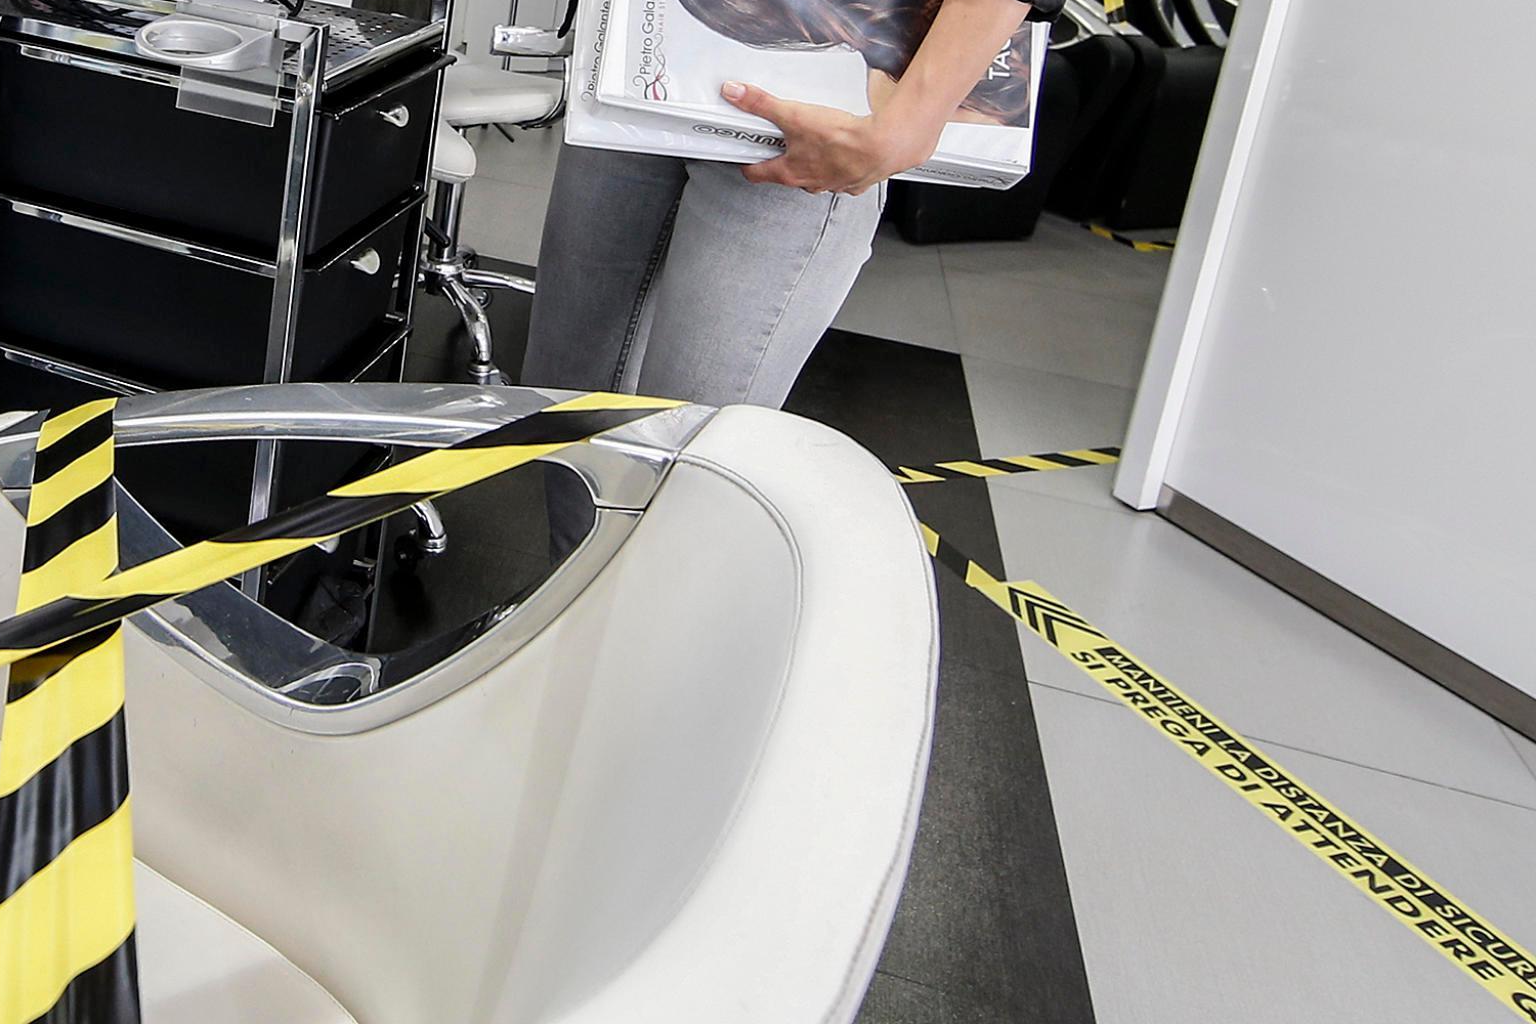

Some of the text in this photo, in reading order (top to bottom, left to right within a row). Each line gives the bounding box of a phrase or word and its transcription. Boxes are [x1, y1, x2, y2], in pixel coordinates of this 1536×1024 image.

[639, 37, 653, 75] Pietro
[1071, 651, 1106, 671] SI
[1104, 677, 1212, 757] PREGA
[1214, 763, 1263, 792] DI
[1260, 801, 1505, 982] ATTENDERE
[1104, 653, 1221, 735] MANTIENI
[1218, 739, 1252, 764] LA
[1254, 767, 1390, 868] DISTANZA
[1394, 873, 1434, 897] DI
